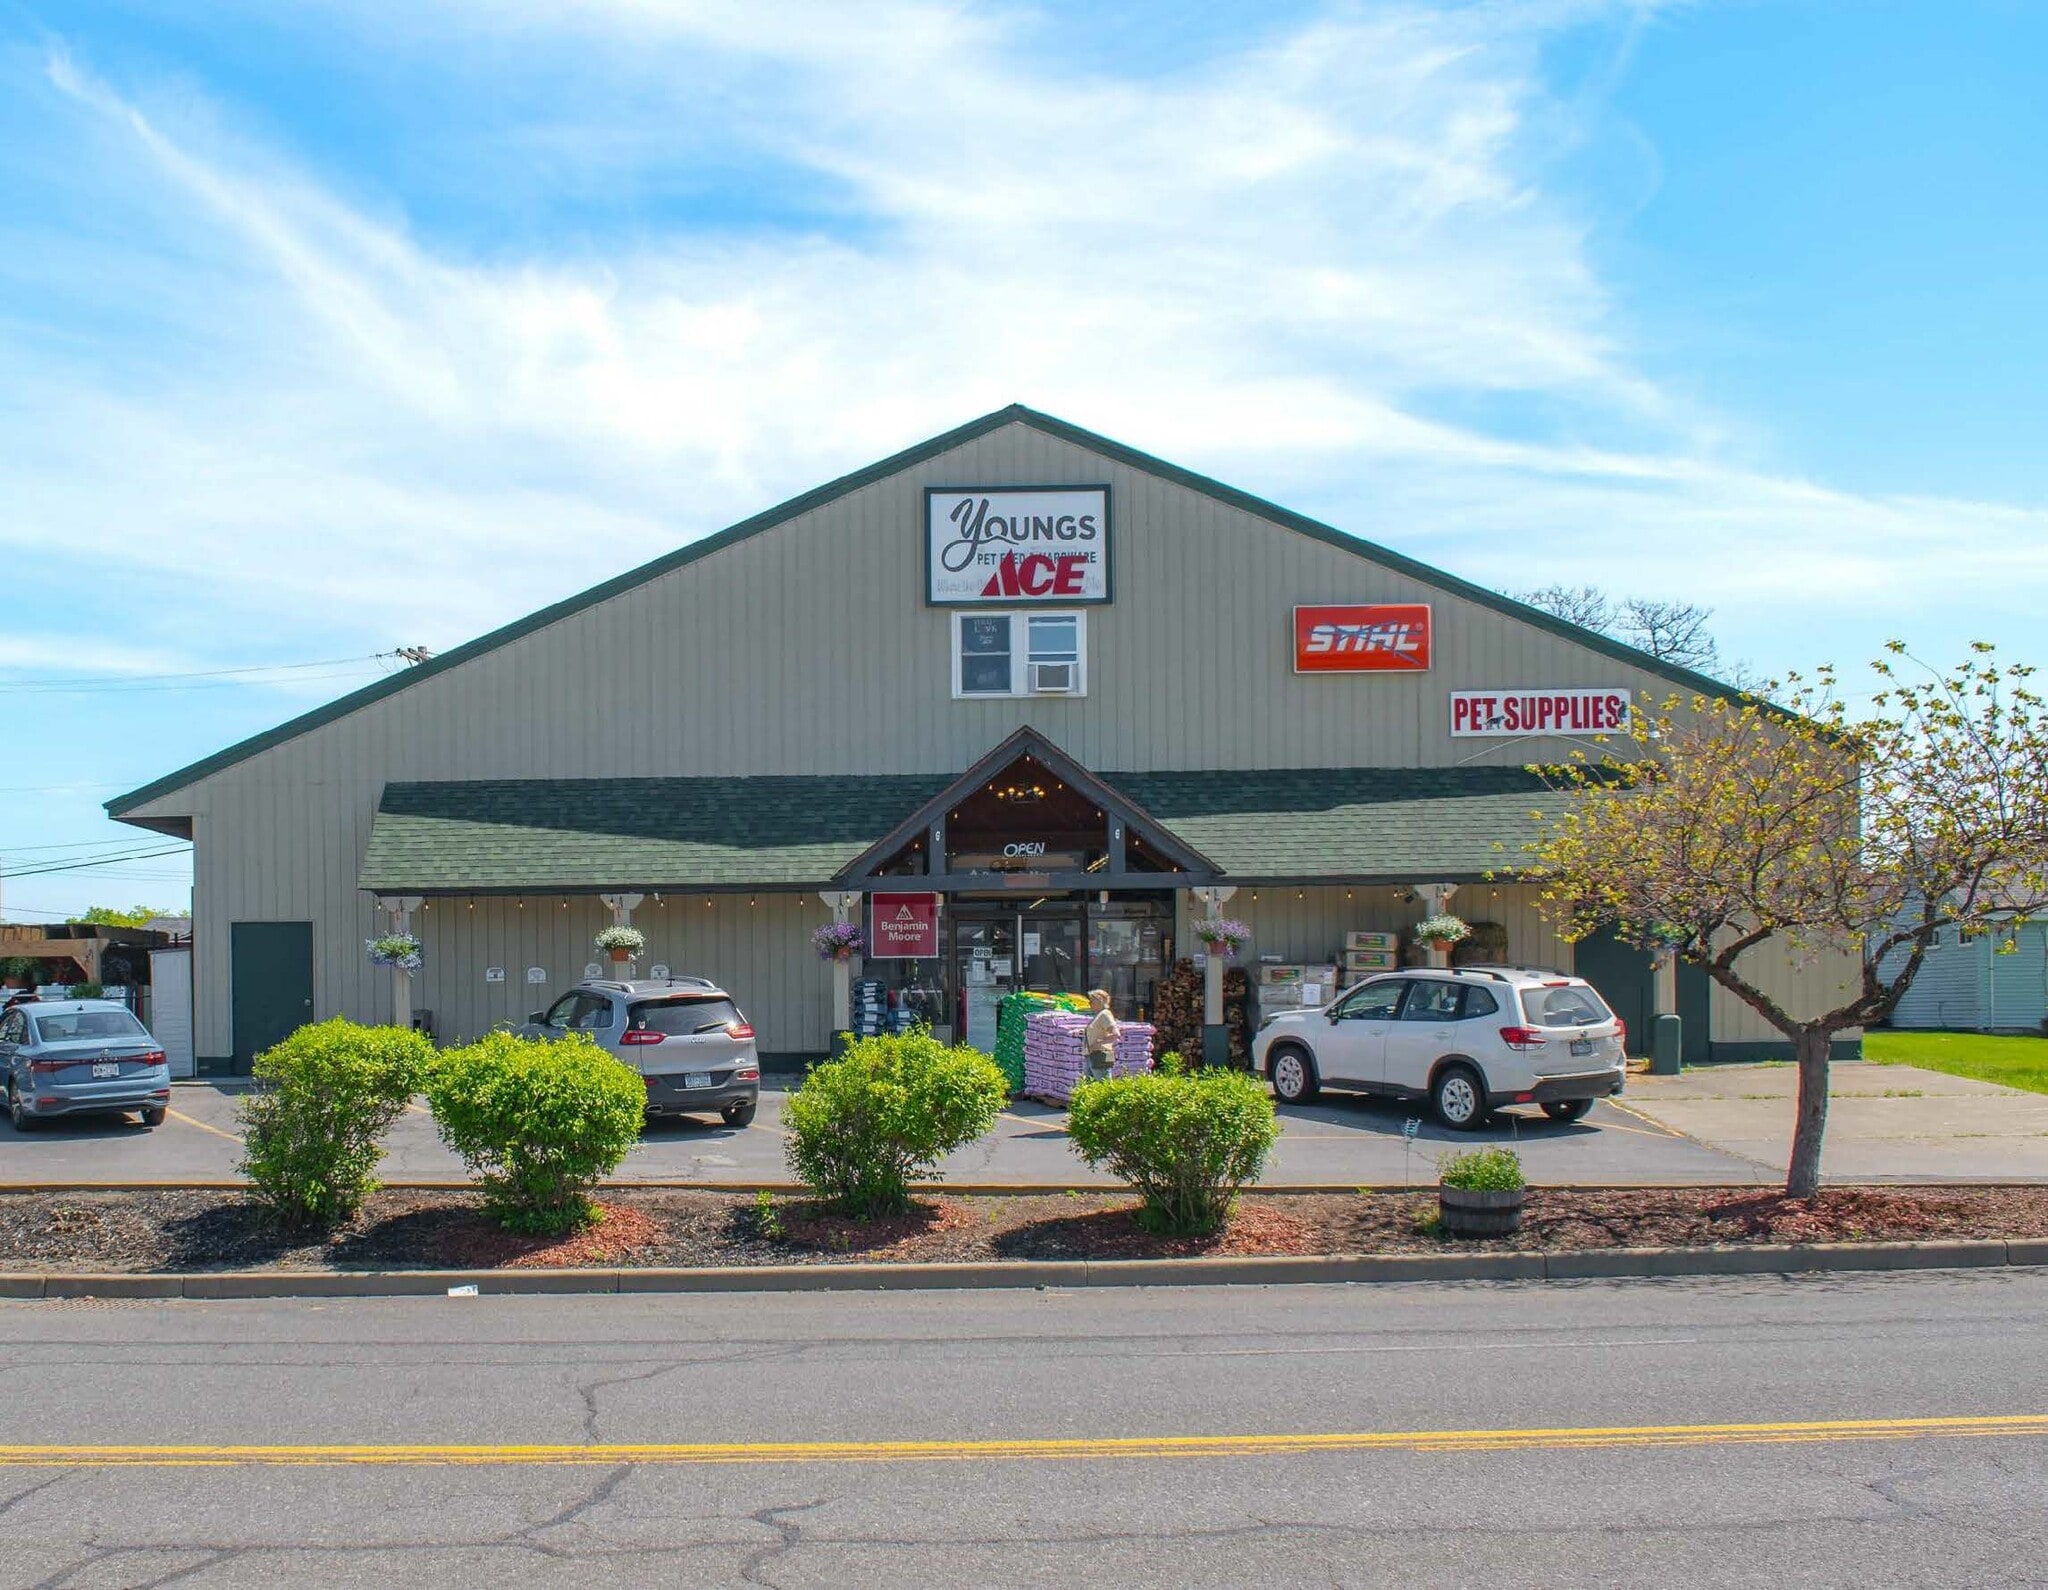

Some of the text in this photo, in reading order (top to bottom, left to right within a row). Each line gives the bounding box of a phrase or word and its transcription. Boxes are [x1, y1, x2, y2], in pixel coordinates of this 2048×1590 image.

[977, 553, 997, 565] PET
[1000, 552, 1026, 565] FED
[980, 548, 1087, 597] ACE
[1306, 623, 1419, 653] STIHL
[1454, 695, 1621, 731] PET SUPPLIES
[1003, 842, 1045, 858] OPEN
[881, 921, 928, 932] Benjamin
[888, 932, 921, 941] Moore
